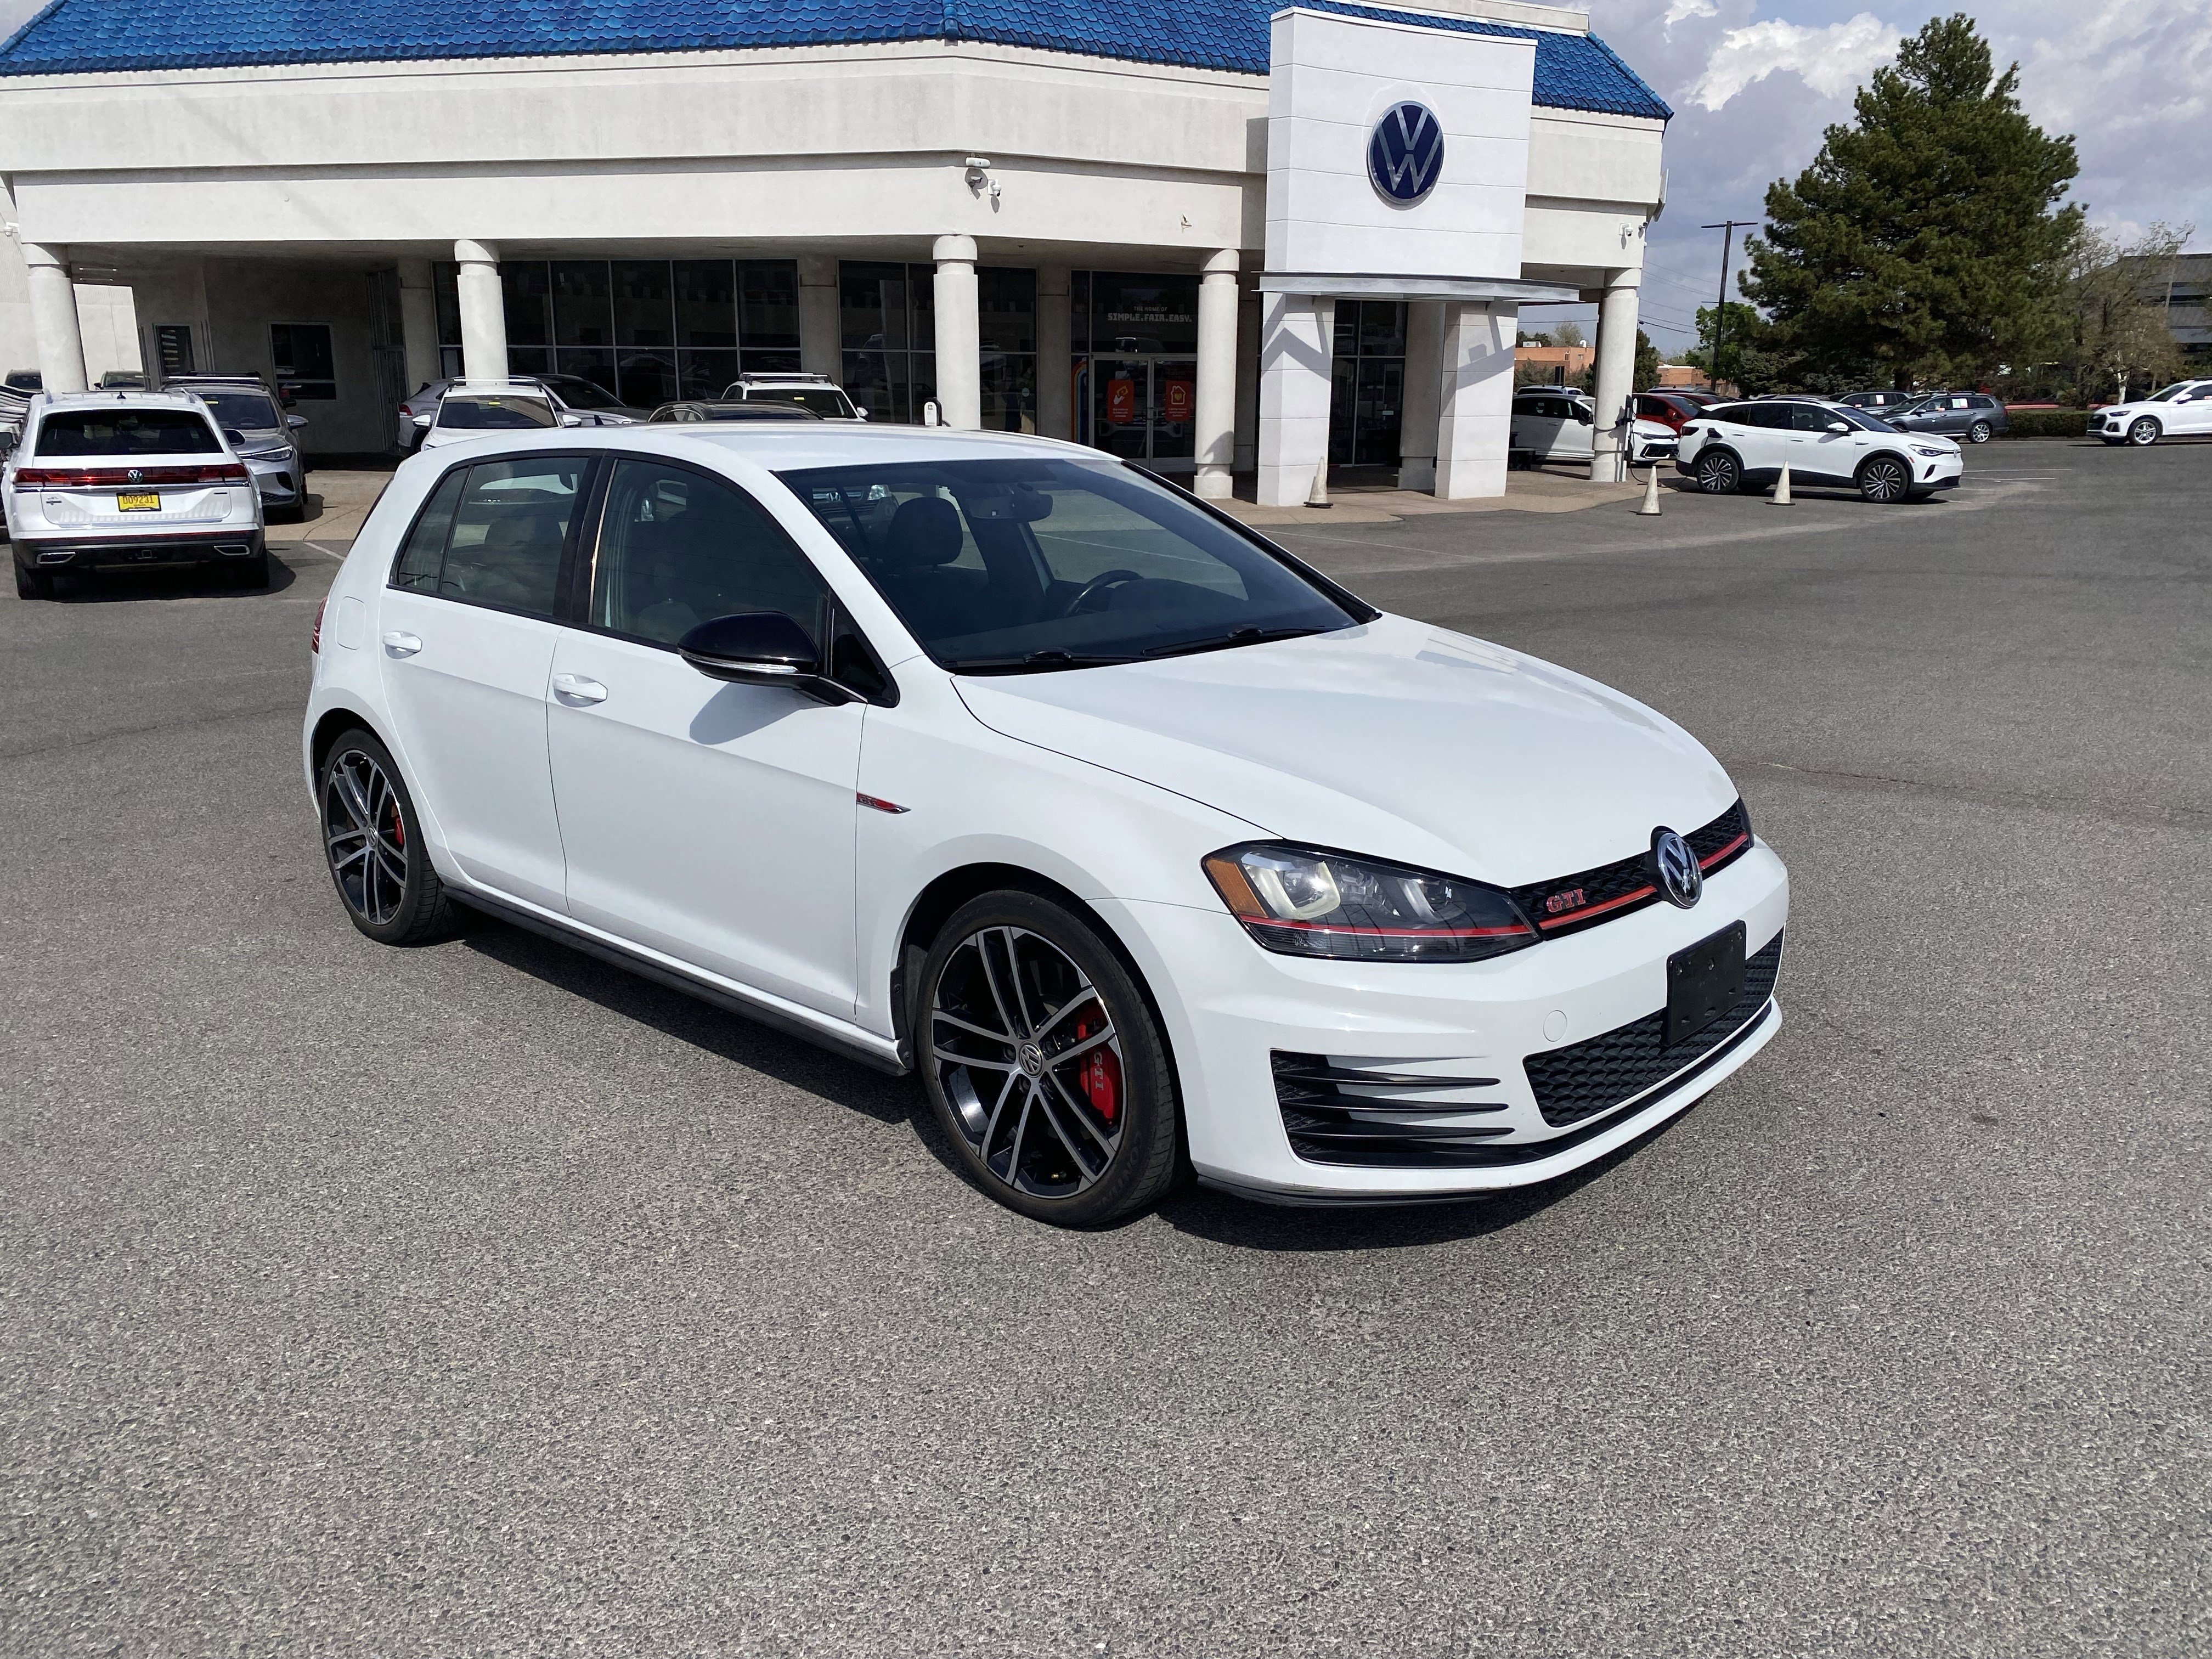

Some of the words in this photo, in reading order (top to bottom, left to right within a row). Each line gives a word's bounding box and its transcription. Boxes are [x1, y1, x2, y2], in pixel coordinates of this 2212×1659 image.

[1107, 312, 1192, 323] SIMPLE.FAIR.EASY.
[1547, 889, 1586, 913] GTI
[1094, 1051, 1104, 1091] GTI
